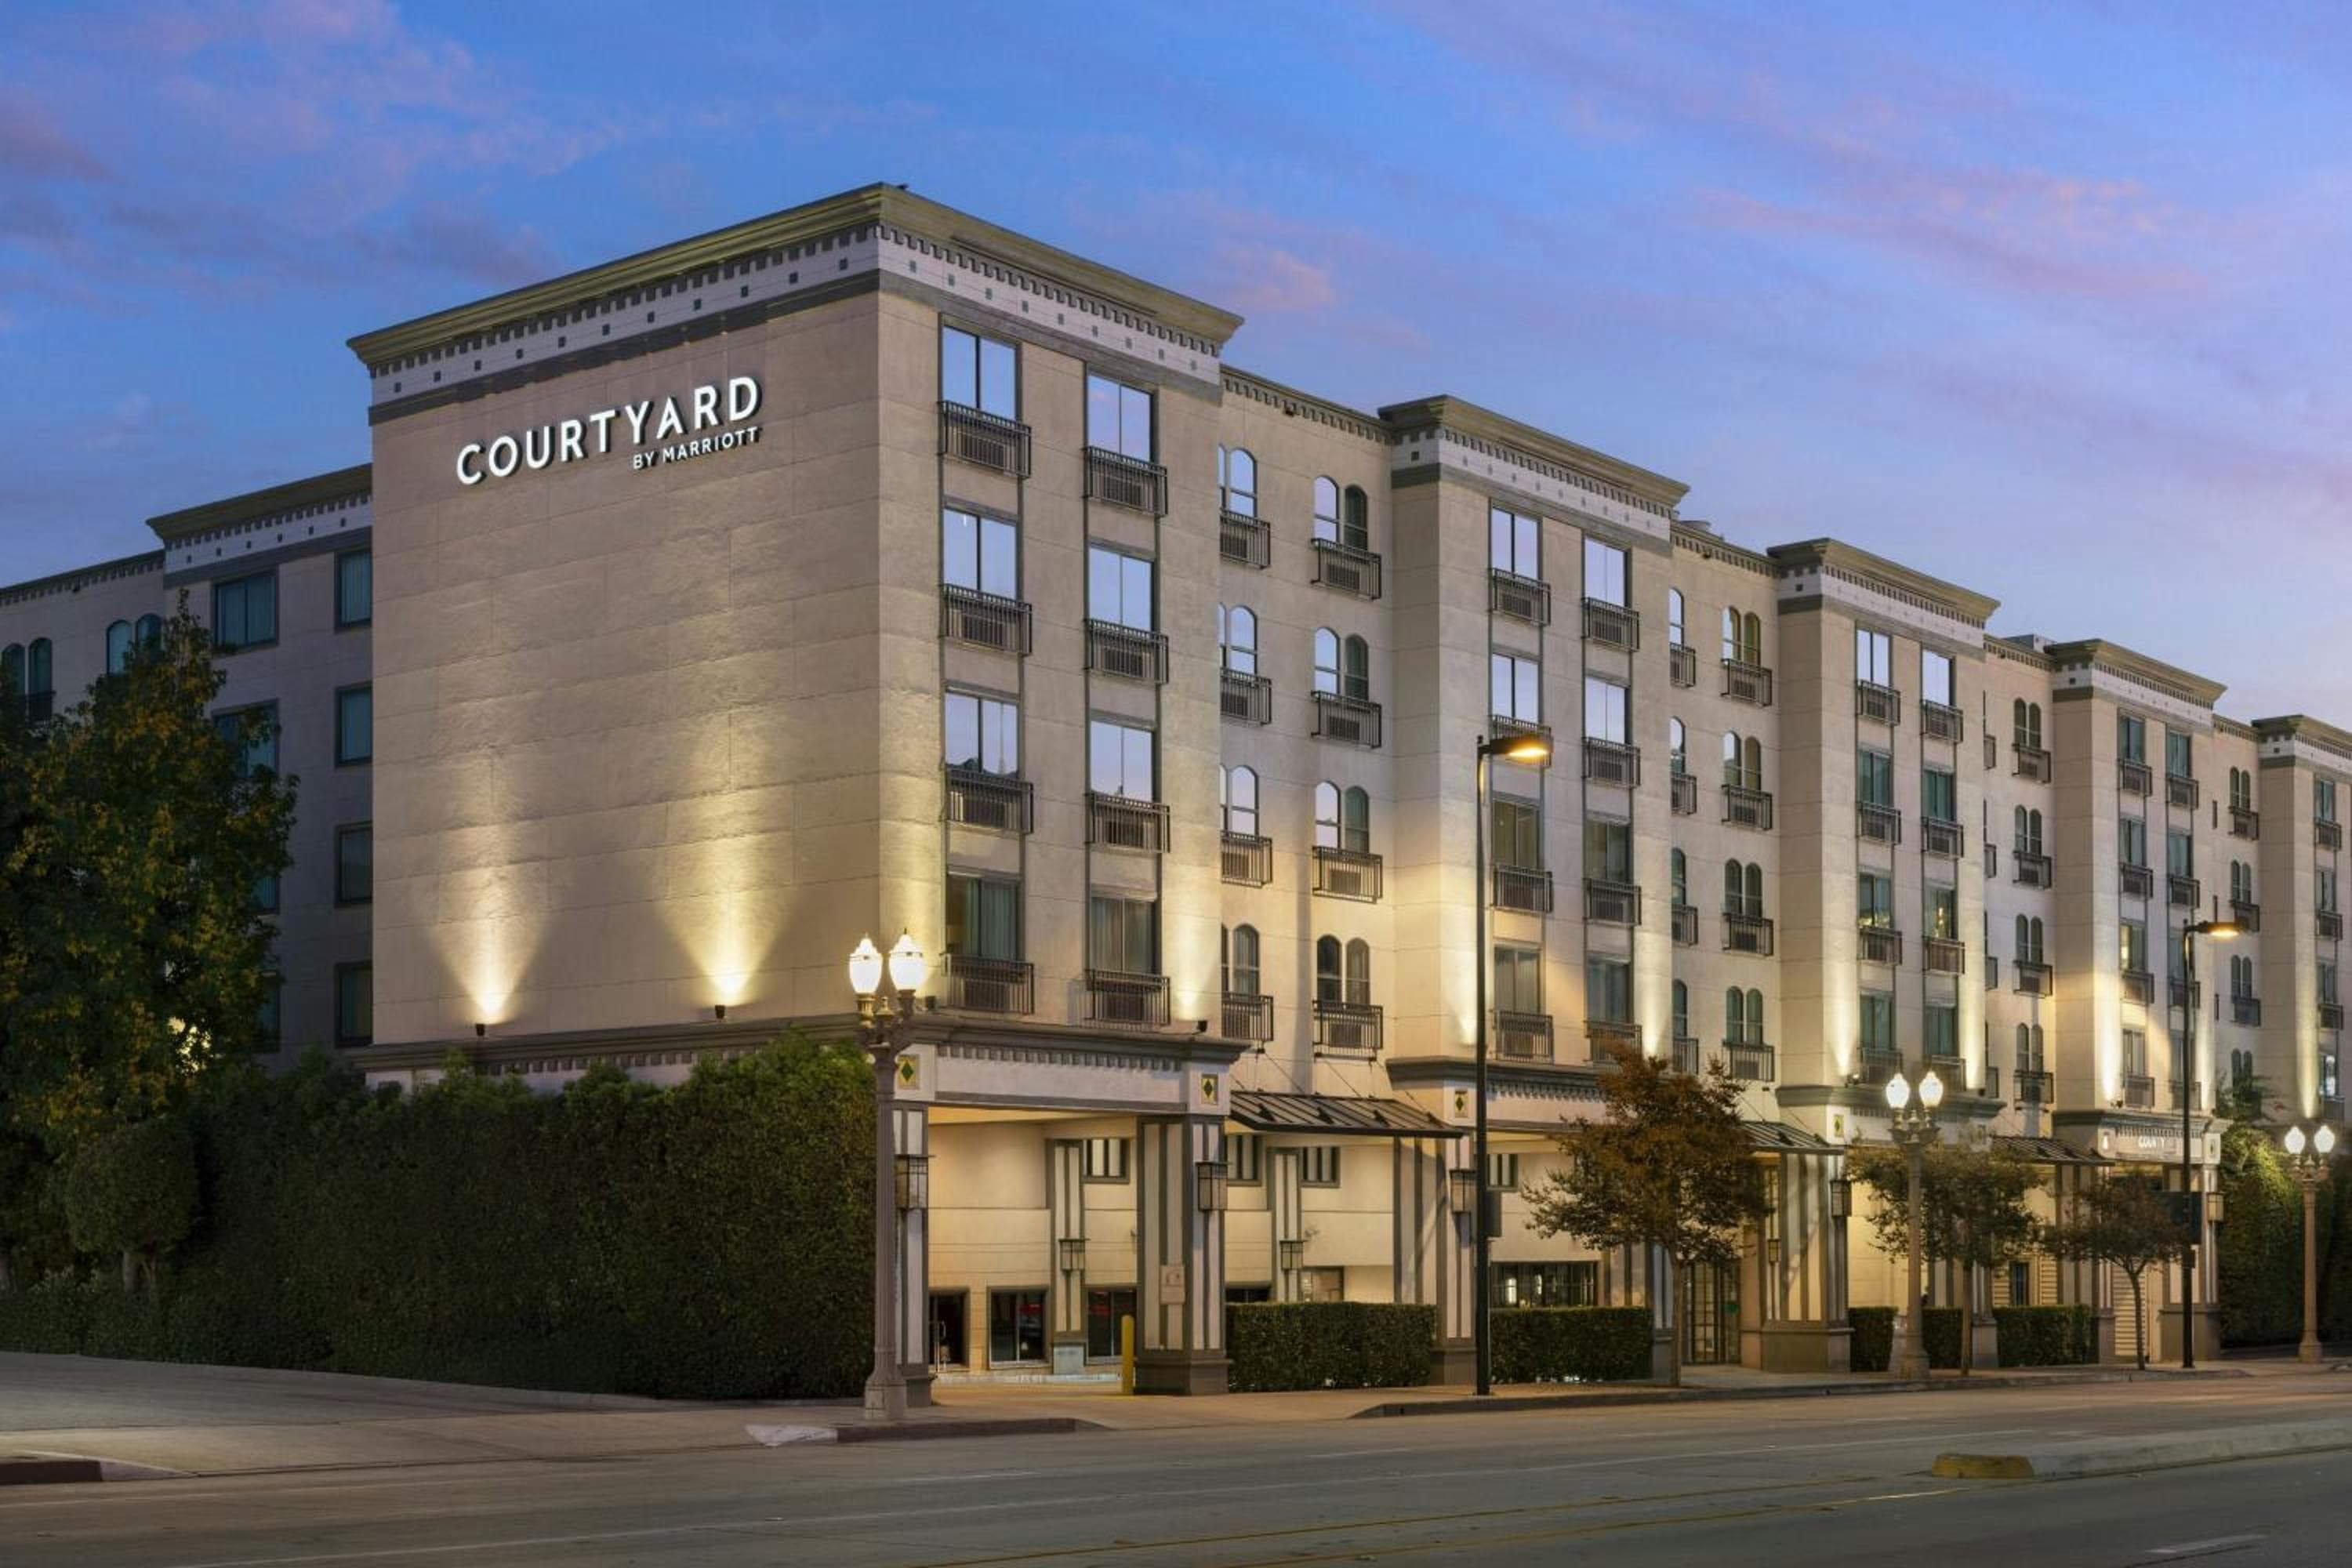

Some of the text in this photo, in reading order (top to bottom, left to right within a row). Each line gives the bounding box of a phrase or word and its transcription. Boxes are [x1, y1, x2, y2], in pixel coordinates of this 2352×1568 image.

[456, 376, 760, 485] COURTYARD
[633, 426, 760, 470] BY MARRIOTT
